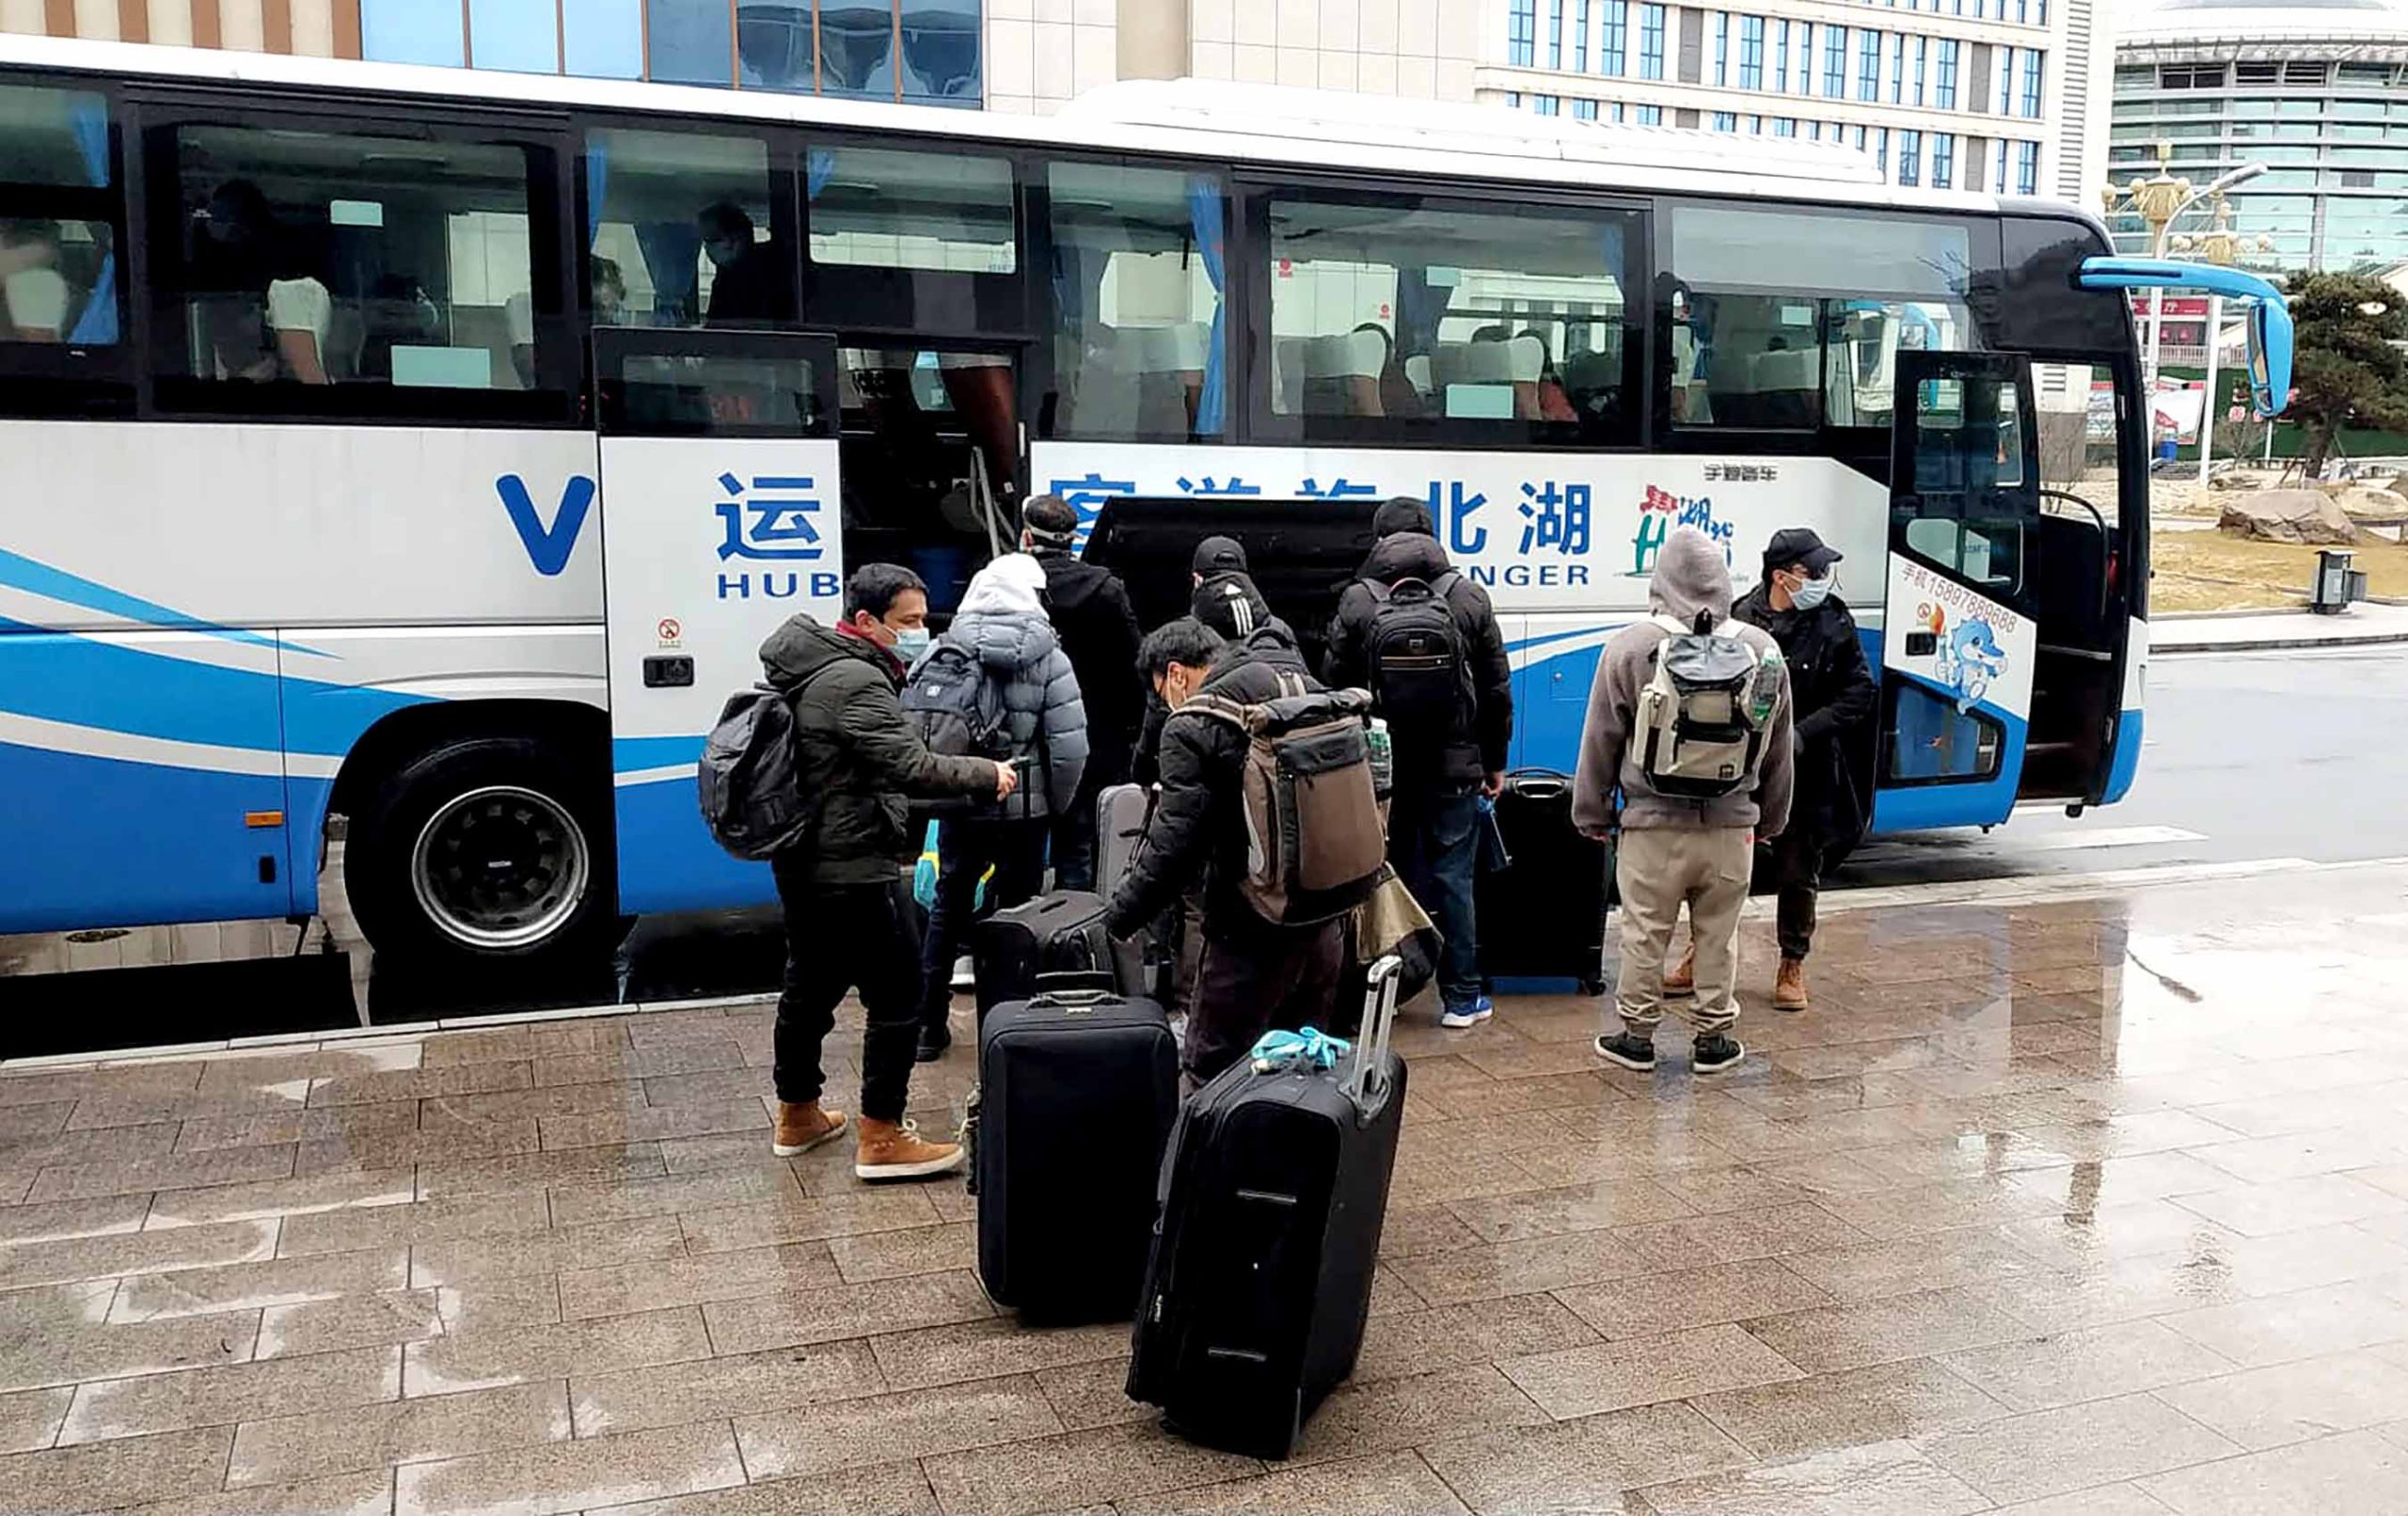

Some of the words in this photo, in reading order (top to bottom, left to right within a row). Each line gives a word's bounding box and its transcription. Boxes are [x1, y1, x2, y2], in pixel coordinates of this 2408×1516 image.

[497, 475, 595, 576] V
[718, 574, 840, 598] HUB
[1454, 565, 1589, 586] NGER
